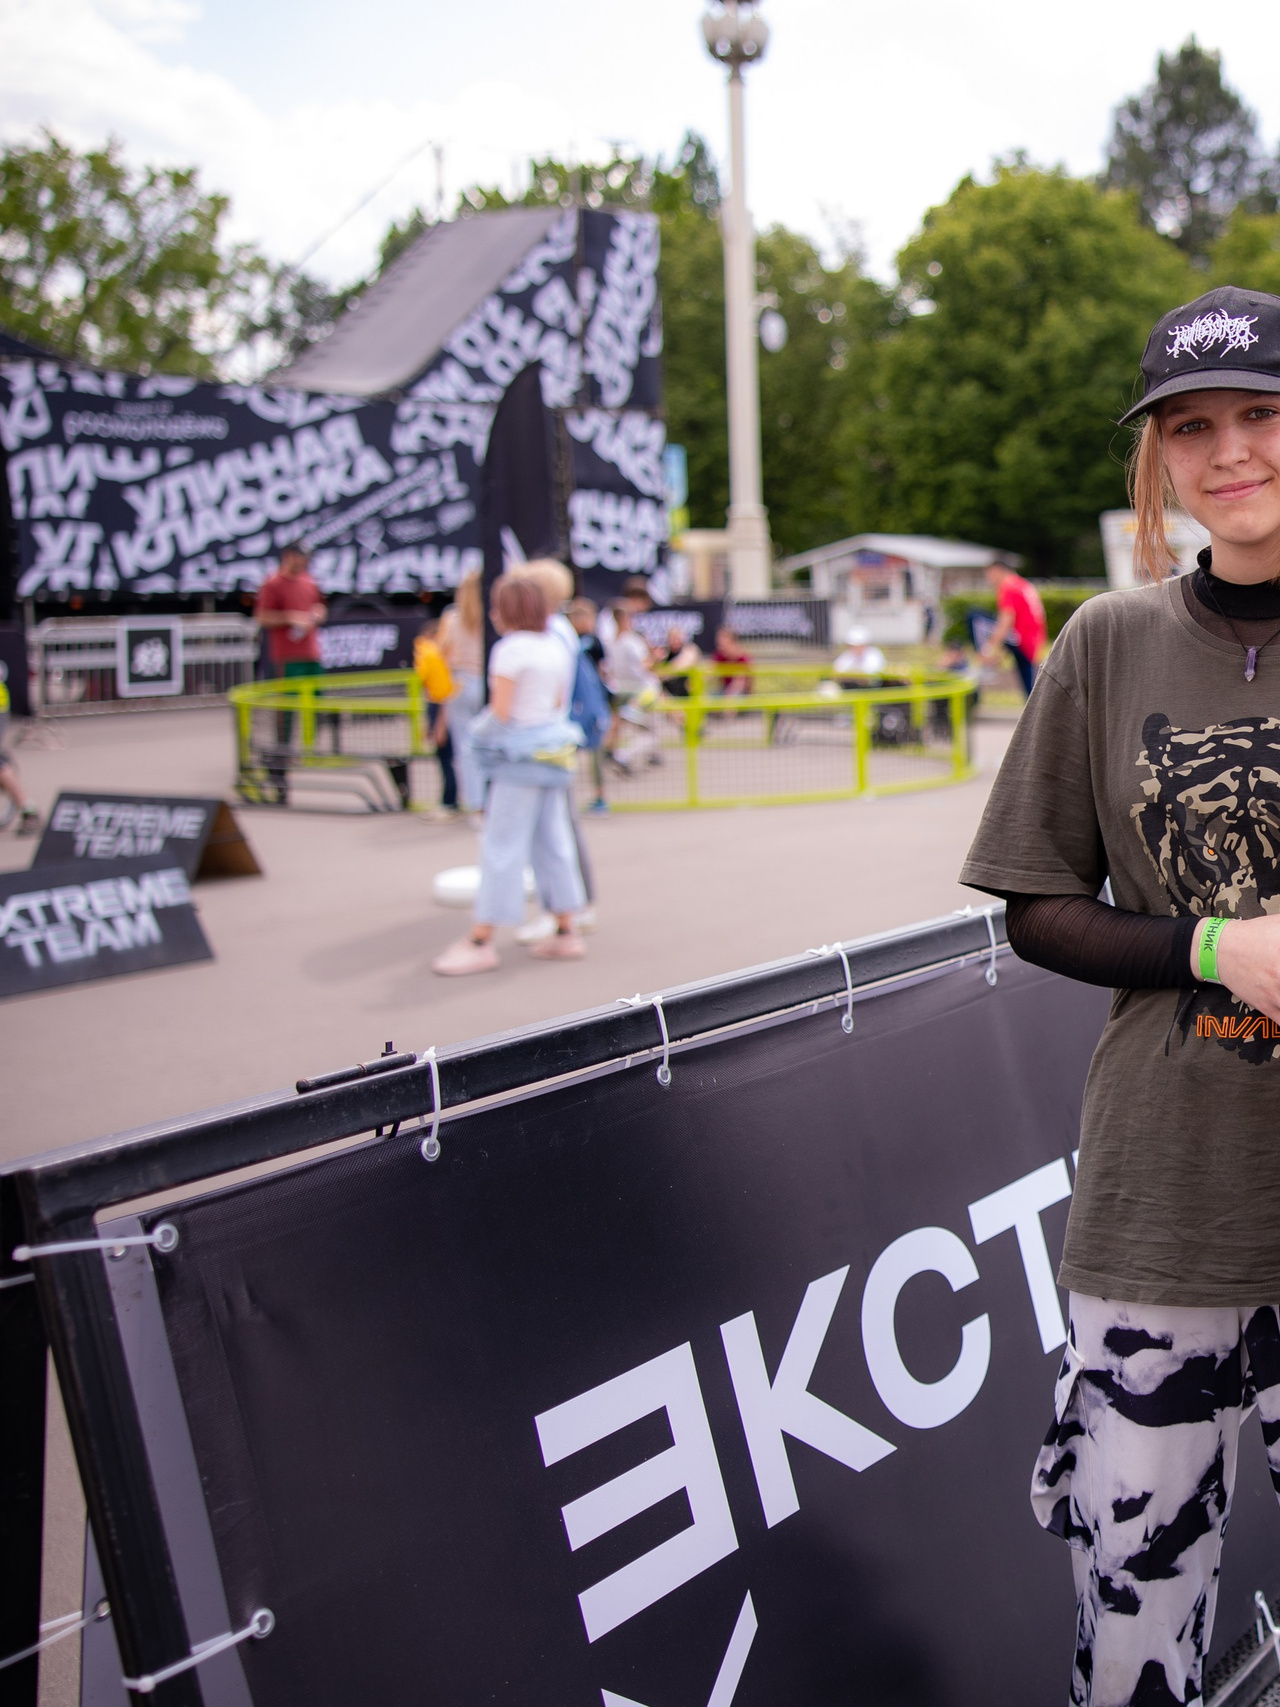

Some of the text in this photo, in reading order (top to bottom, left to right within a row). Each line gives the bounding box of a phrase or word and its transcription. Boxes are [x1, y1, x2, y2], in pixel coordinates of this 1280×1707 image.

[112, 445, 394, 579] КЛАССИКА
[122, 413, 366, 531] УЛИЧНАЯ
[52, 800, 207, 840] EXTREME
[74, 833, 165, 861] TEAM
[5, 909, 163, 968] TEAM
[534, 1150, 1080, 1644] ЭКСТ
